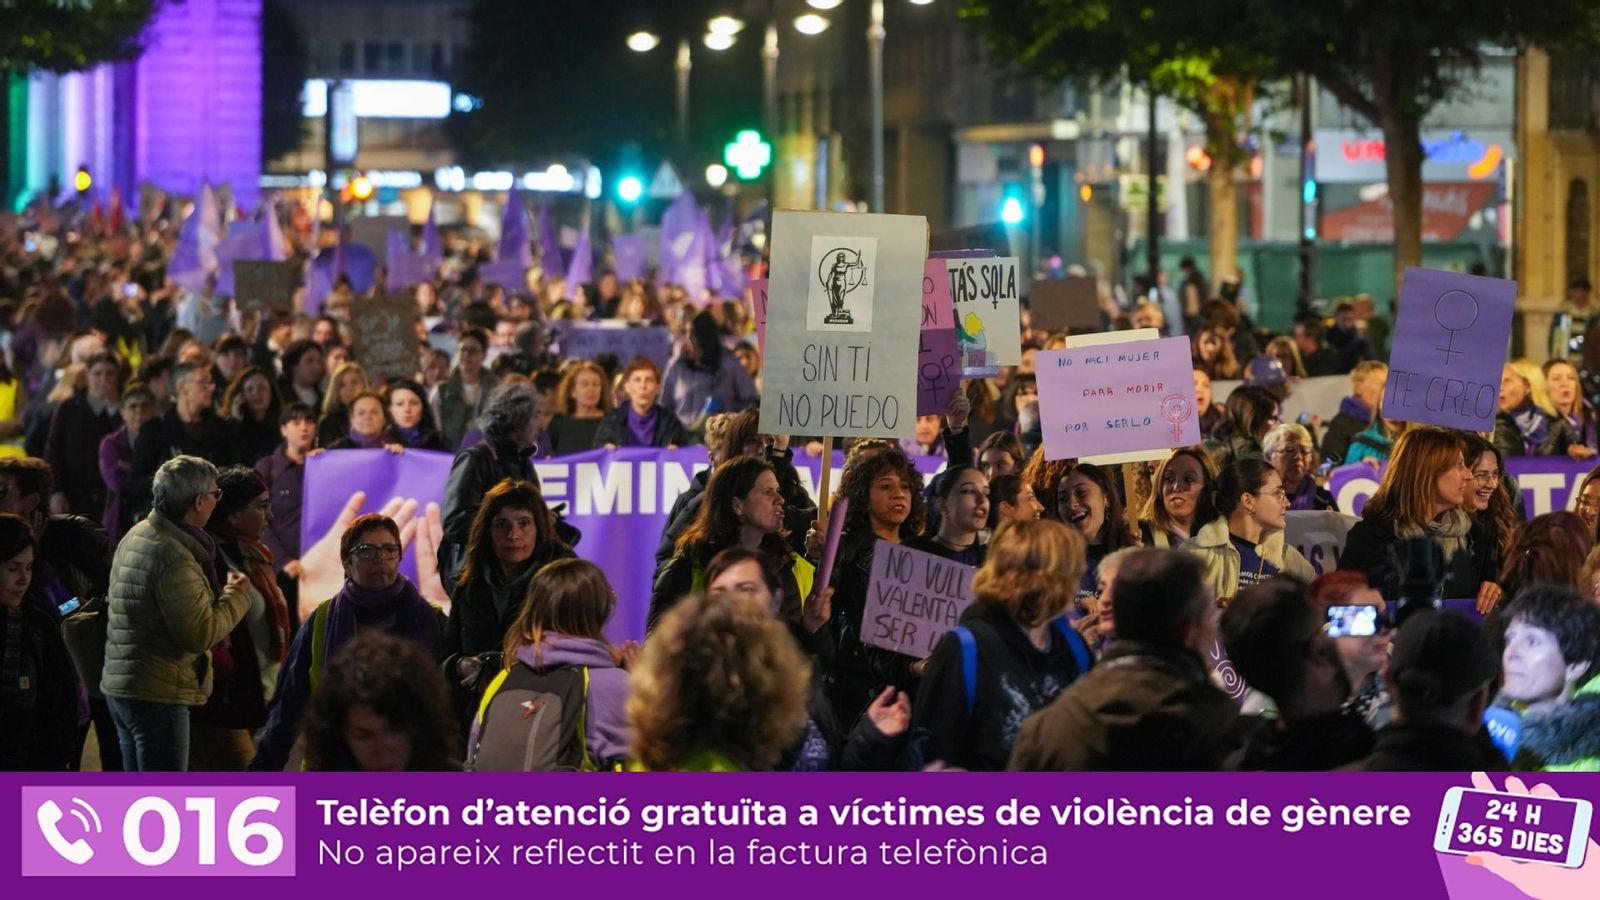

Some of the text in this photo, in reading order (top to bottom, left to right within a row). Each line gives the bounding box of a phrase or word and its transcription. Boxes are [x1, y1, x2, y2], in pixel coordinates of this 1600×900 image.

[981, 265, 1016, 309] SOLA
[803, 344, 838, 382] SIN
[1058, 357, 1073, 368] NO
[1118, 351, 1161, 362] MUJER
[1083, 383, 1164, 397] PARA MORIR
[1391, 369, 1496, 420] TE CREO
[779, 393, 899, 430] NO PUEDO
[1065, 417, 1151, 433] POR SERLO
[885, 547, 966, 600] NO VULL
[876, 581, 959, 626] VALENTA
[873, 614, 917, 646] SER
